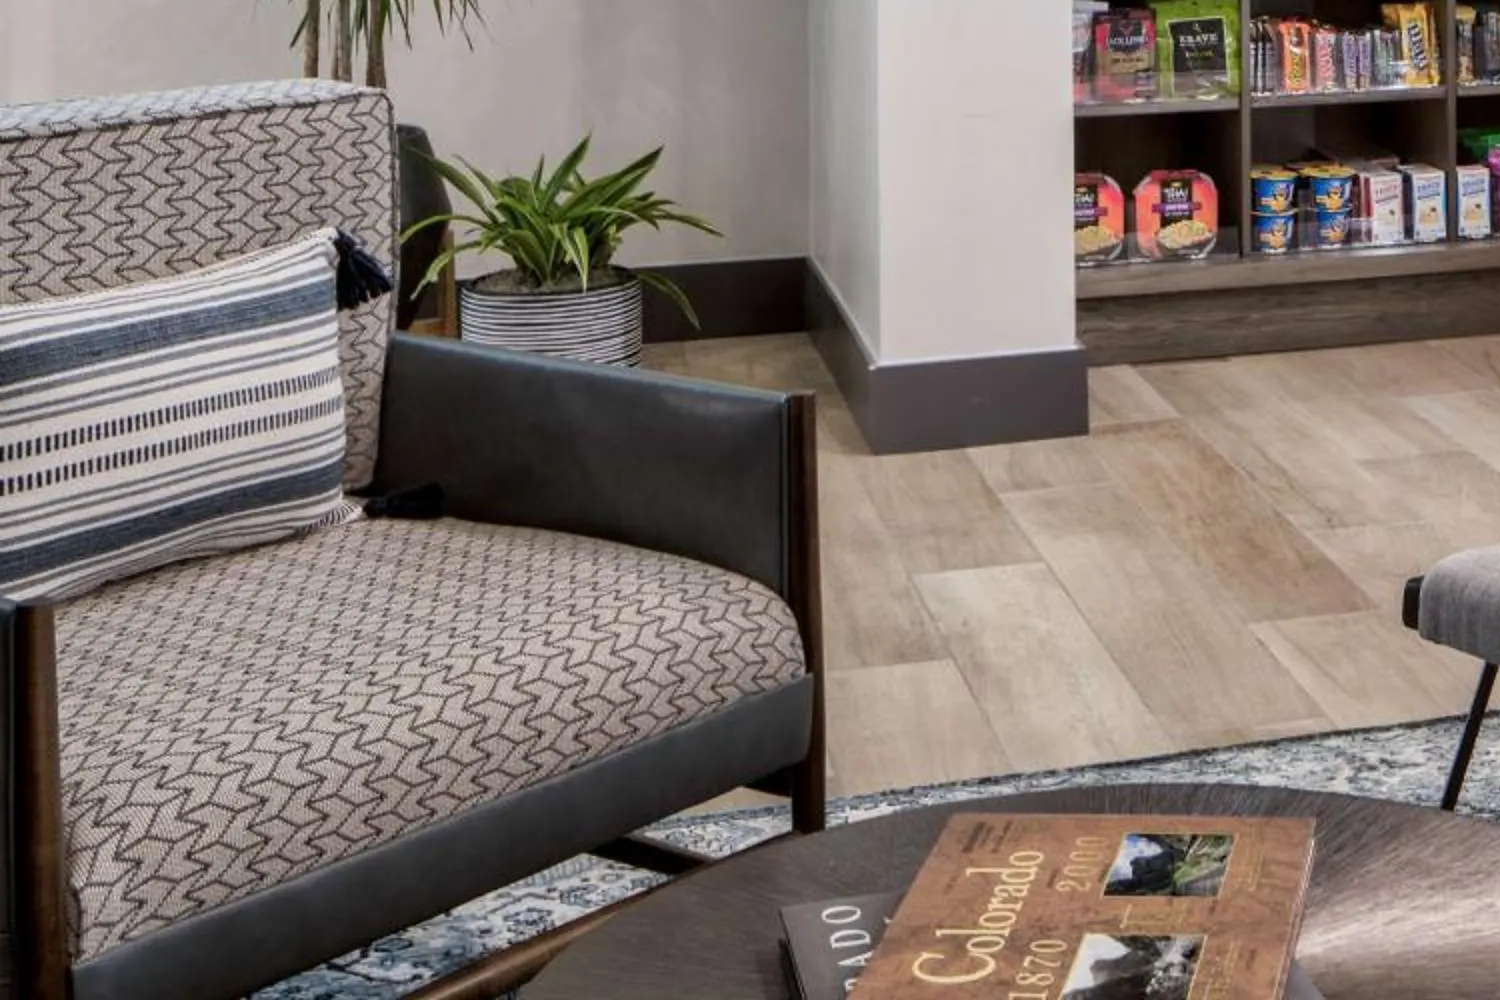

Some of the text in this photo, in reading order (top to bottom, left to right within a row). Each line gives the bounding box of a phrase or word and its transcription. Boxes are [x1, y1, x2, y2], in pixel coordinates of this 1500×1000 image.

[912, 851, 1045, 984] Colorado
[1008, 836, 1110, 1000] 1870 2000
